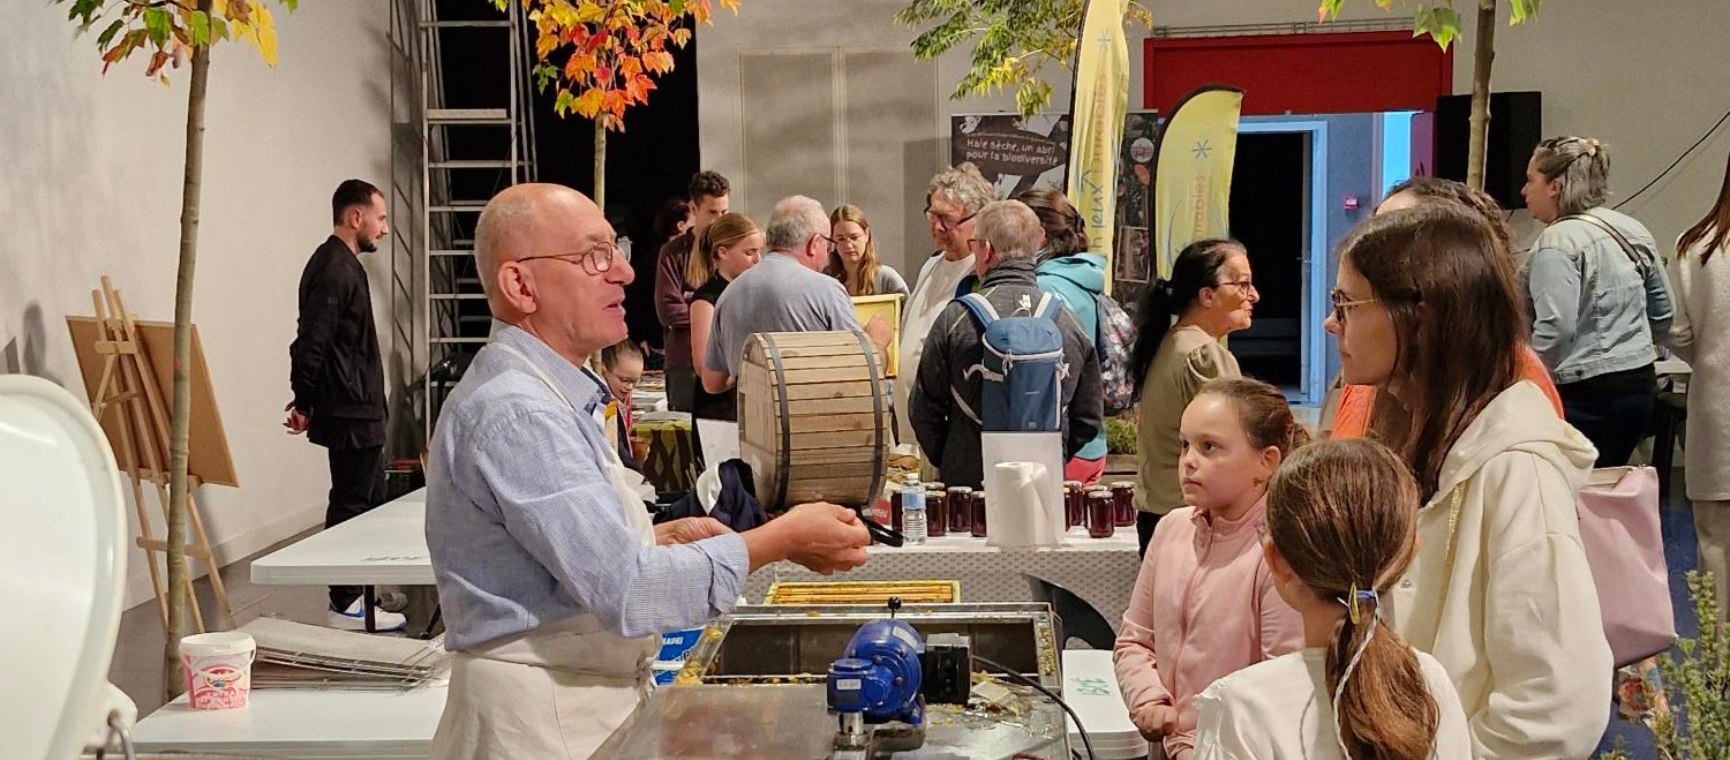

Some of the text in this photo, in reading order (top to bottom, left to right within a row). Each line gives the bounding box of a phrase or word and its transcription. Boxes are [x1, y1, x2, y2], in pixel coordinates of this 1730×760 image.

[1092, 74, 1106, 173] Durables
[966, 138, 1055, 154] Haie sèche, un abri
[966, 150, 1059, 166] pour la biodiversité
[1191, 173, 1206, 241] urables
